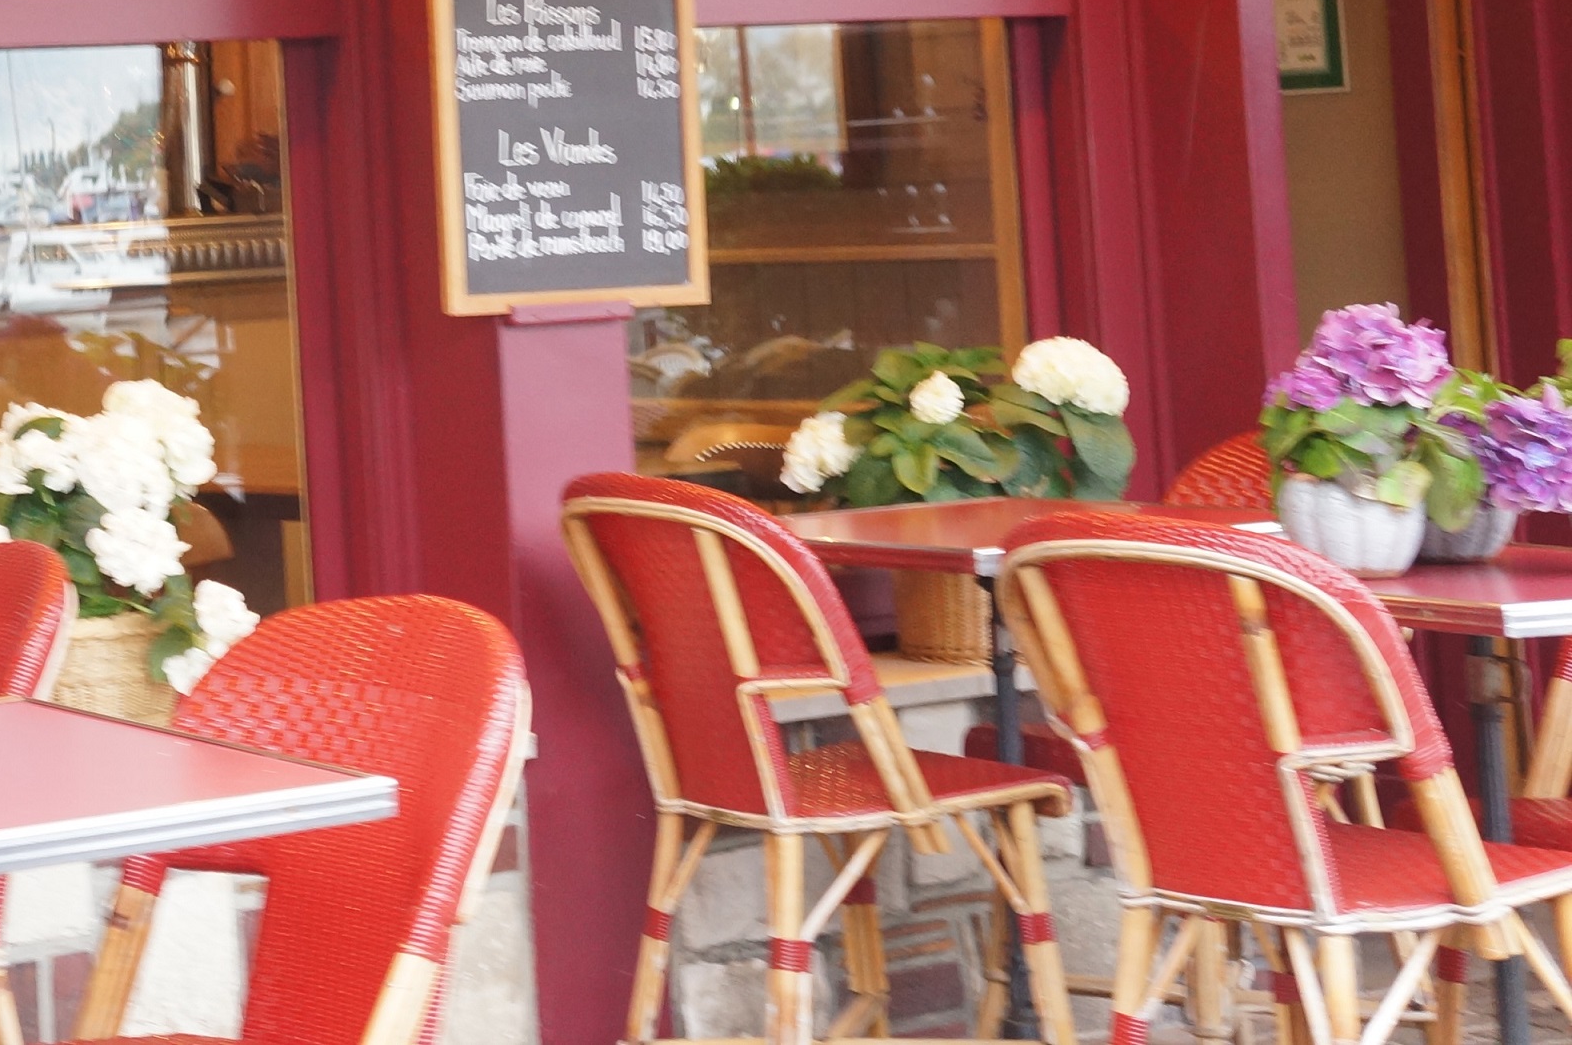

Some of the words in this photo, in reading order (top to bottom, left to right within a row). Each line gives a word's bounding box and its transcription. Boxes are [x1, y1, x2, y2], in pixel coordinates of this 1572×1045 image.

[522, 22, 548, 54] de
[546, 17, 624, 52] cabillaud
[488, 50, 515, 77] de
[454, 77, 527, 103] Saumon
[497, 127, 540, 167] Les
[538, 126, 619, 167] Viandes
[501, 170, 528, 202] de
[525, 179, 572, 199] veau
[533, 199, 562, 231] de
[560, 190, 624, 229] canard
[516, 229, 544, 259] de
